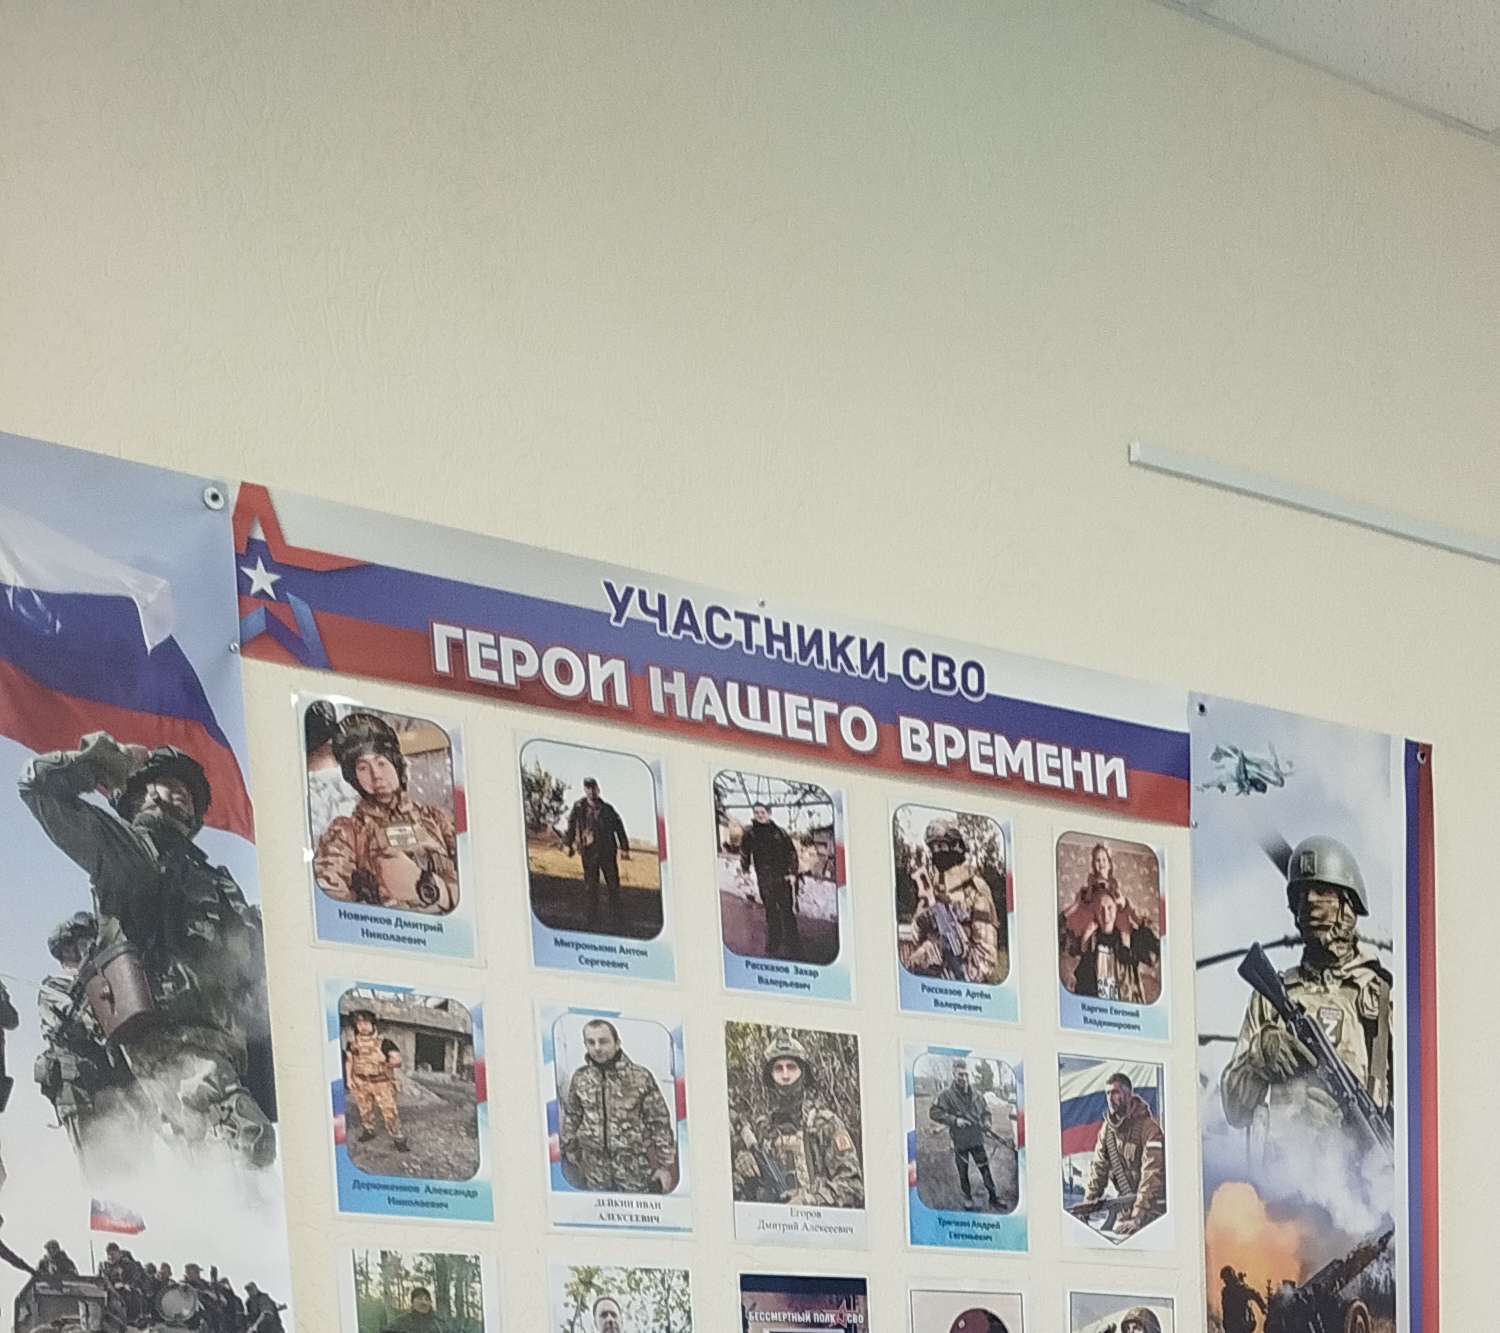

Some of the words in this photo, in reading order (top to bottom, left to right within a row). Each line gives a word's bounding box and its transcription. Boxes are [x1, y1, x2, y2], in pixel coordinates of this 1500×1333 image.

[601, 580, 888, 682] УЧАСТНИКИ
[900, 647, 986, 701] СВО
[429, 620, 630, 709] ГЕРОИ
[649, 666, 879, 754] НАШЕГО
[899, 717, 1130, 800] ВРЕМЕНИ
[338, 909, 392, 926] Новичков
[394, 917, 444, 933] Дмитрий
[361, 927, 427, 946] Николаевич
[619, 945, 648, 957] Антон
[578, 955, 629, 970] Сергеевич
[745, 960, 790, 974] Рассказов
[793, 965, 820, 979] Захар
[757, 975, 811, 991] Валерьевич
[921, 983, 962, 997] Рассказов
[933, 998, 982, 1012] Валерьевич
[424, 1185, 479, 1199] Александр
[387, 1196, 449, 1209] Николаевич
[599, 1212, 660, 1223] АЛЕКСЕЕВИЧ
[790, 1207, 822, 1220] Егоров
[758, 1219, 799, 1233] Дмитрий
[802, 1222, 854, 1235] Алексеевич
[748, 1310, 811, 1323] БЕССМЕРТНЫЙ
[813, 1312, 835, 1324] ПОЛК
[846, 1314, 864, 1324] СВО
